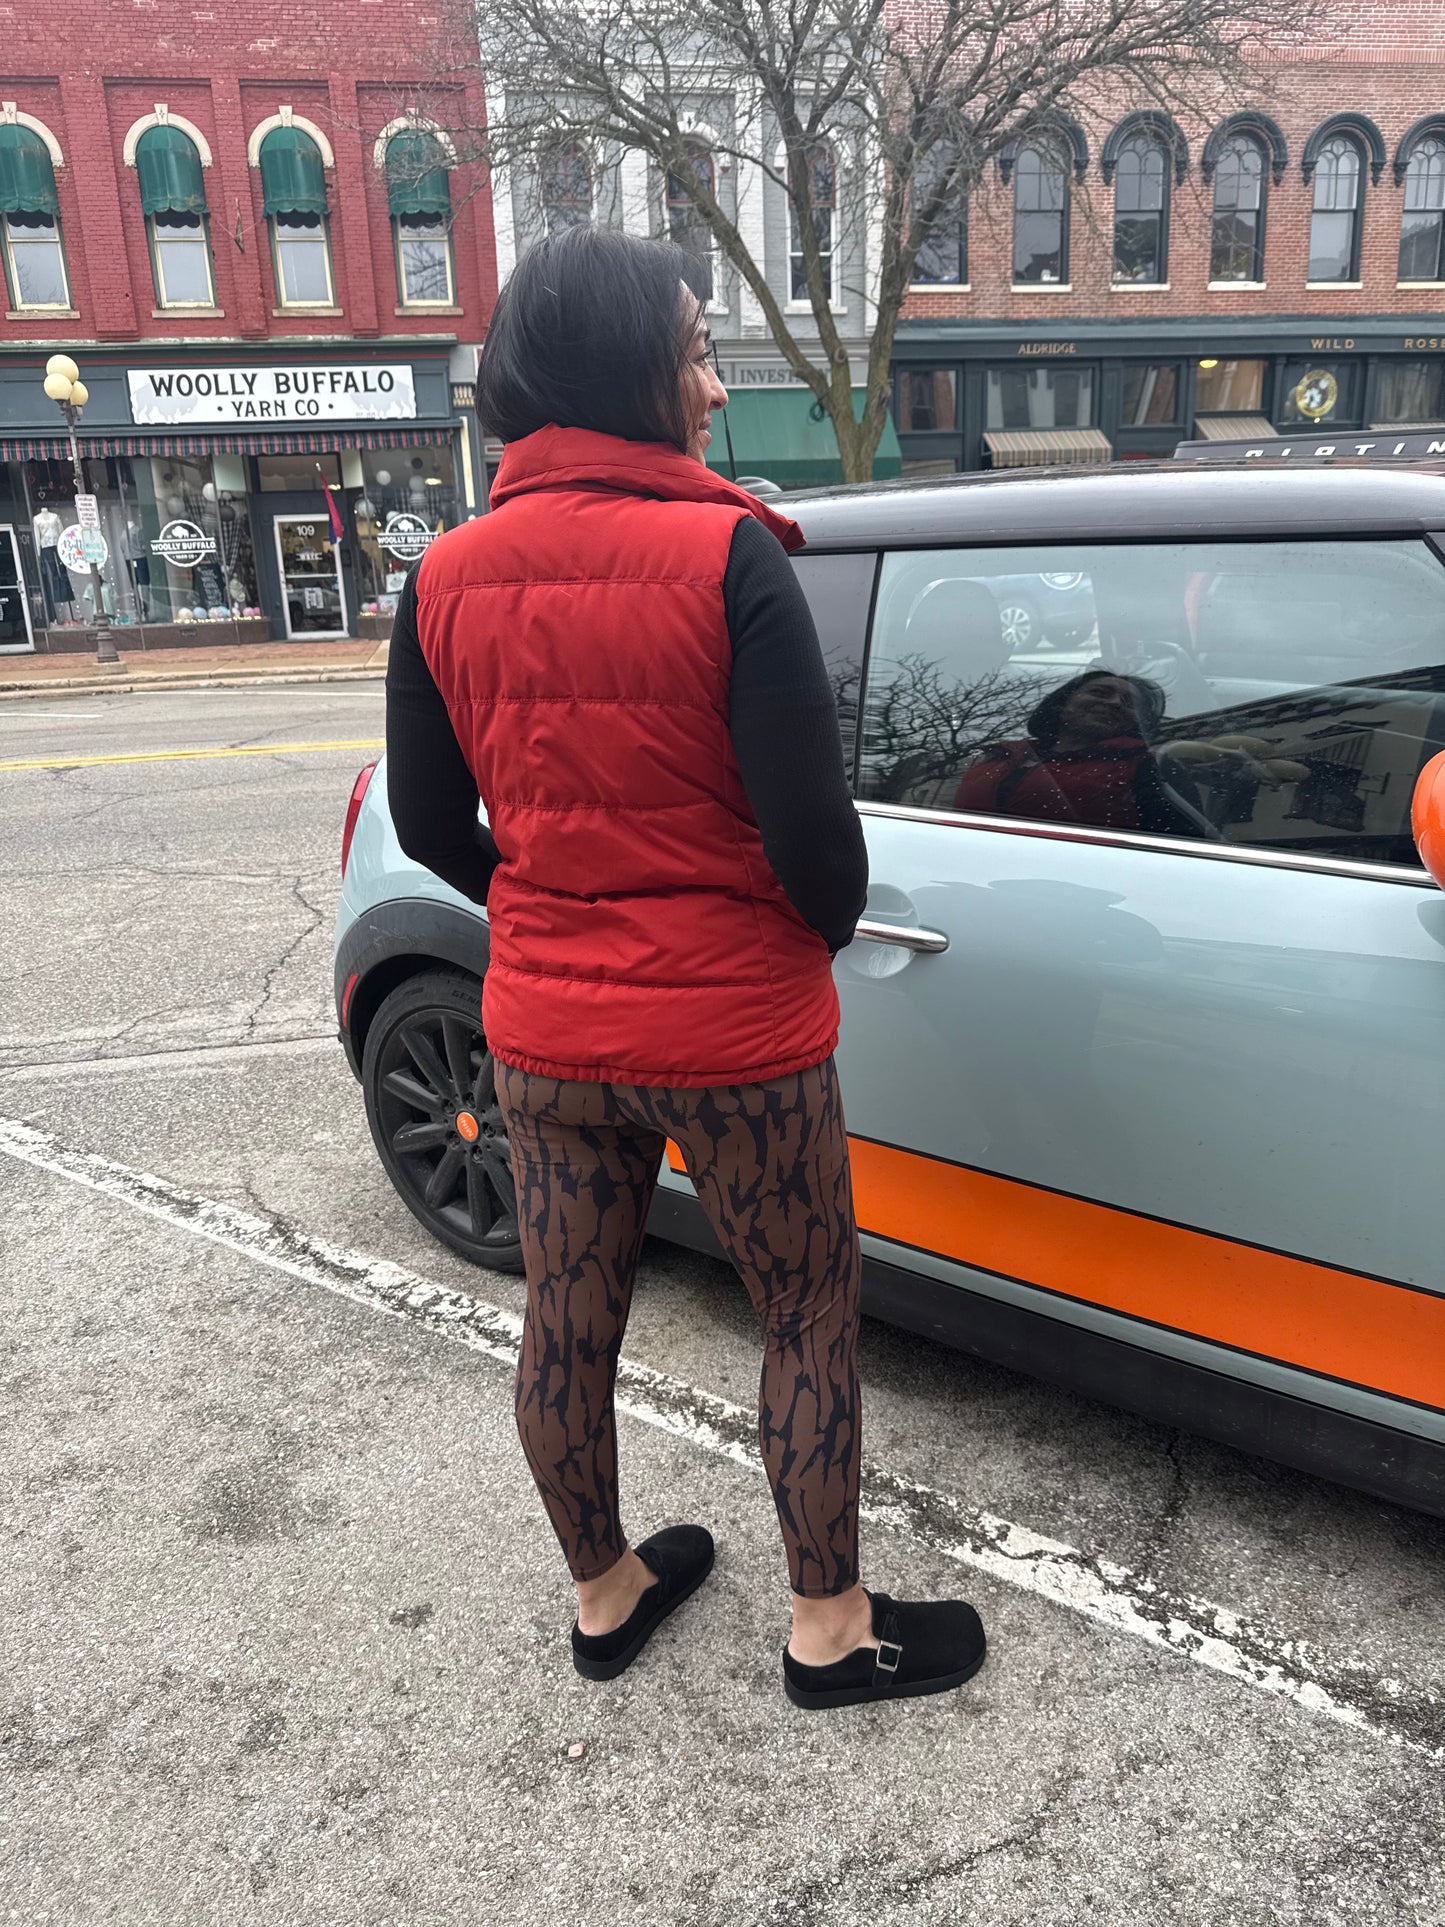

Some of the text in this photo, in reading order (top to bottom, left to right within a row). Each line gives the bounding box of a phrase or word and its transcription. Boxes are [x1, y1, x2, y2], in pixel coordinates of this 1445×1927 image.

[1018, 343, 1076, 354] ALDRIDGE
[1311, 338, 1355, 349] WILD
[740, 368, 799, 384] INVEST
[149, 370, 394, 397] WOOLLY BUFFALO
[231, 399, 319, 418] YARN CO
[296, 525, 315, 536] 109
[376, 535, 437, 544] WOOLLY BUFFAL
[150, 541, 216, 551] WOOLLY BUFFALO
[460, 1116, 474, 1137] MINI
